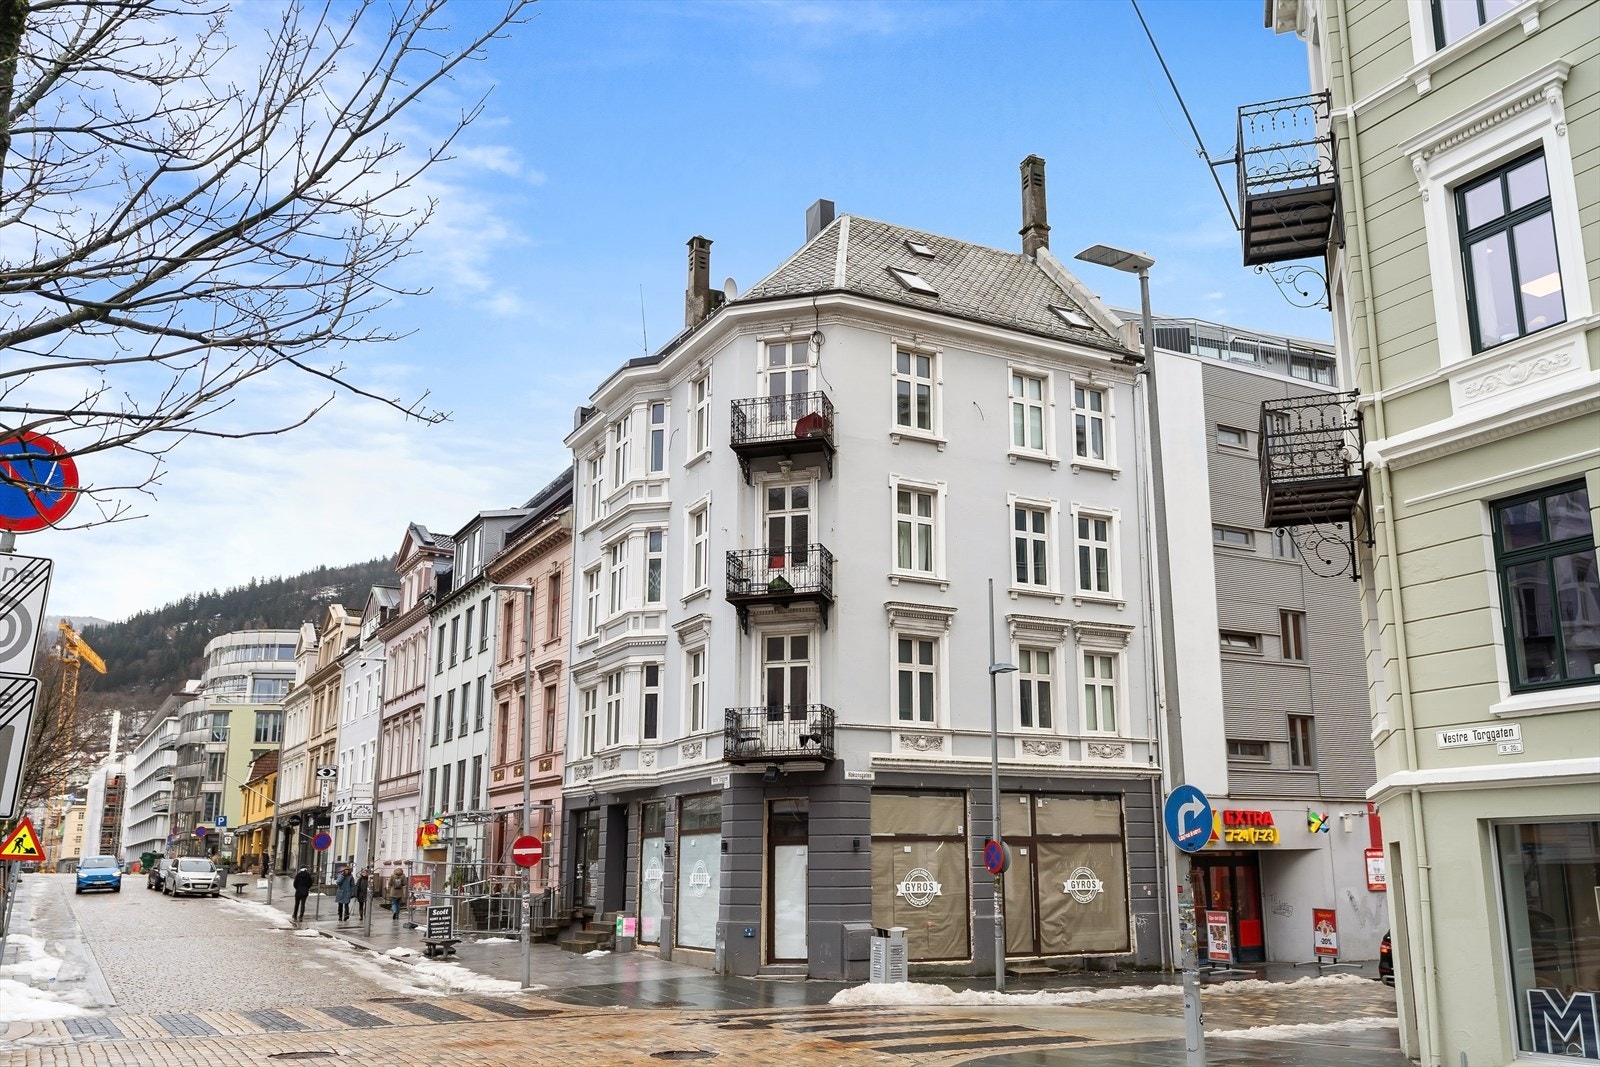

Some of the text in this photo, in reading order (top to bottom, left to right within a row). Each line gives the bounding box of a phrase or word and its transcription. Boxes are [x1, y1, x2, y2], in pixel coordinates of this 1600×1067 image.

[1442, 728, 1514, 744] Vestre Torggaten
[1224, 810, 1274, 825] EXTRA
[905, 882, 934, 892] GYROS
[1070, 880, 1097, 889] GYROS
